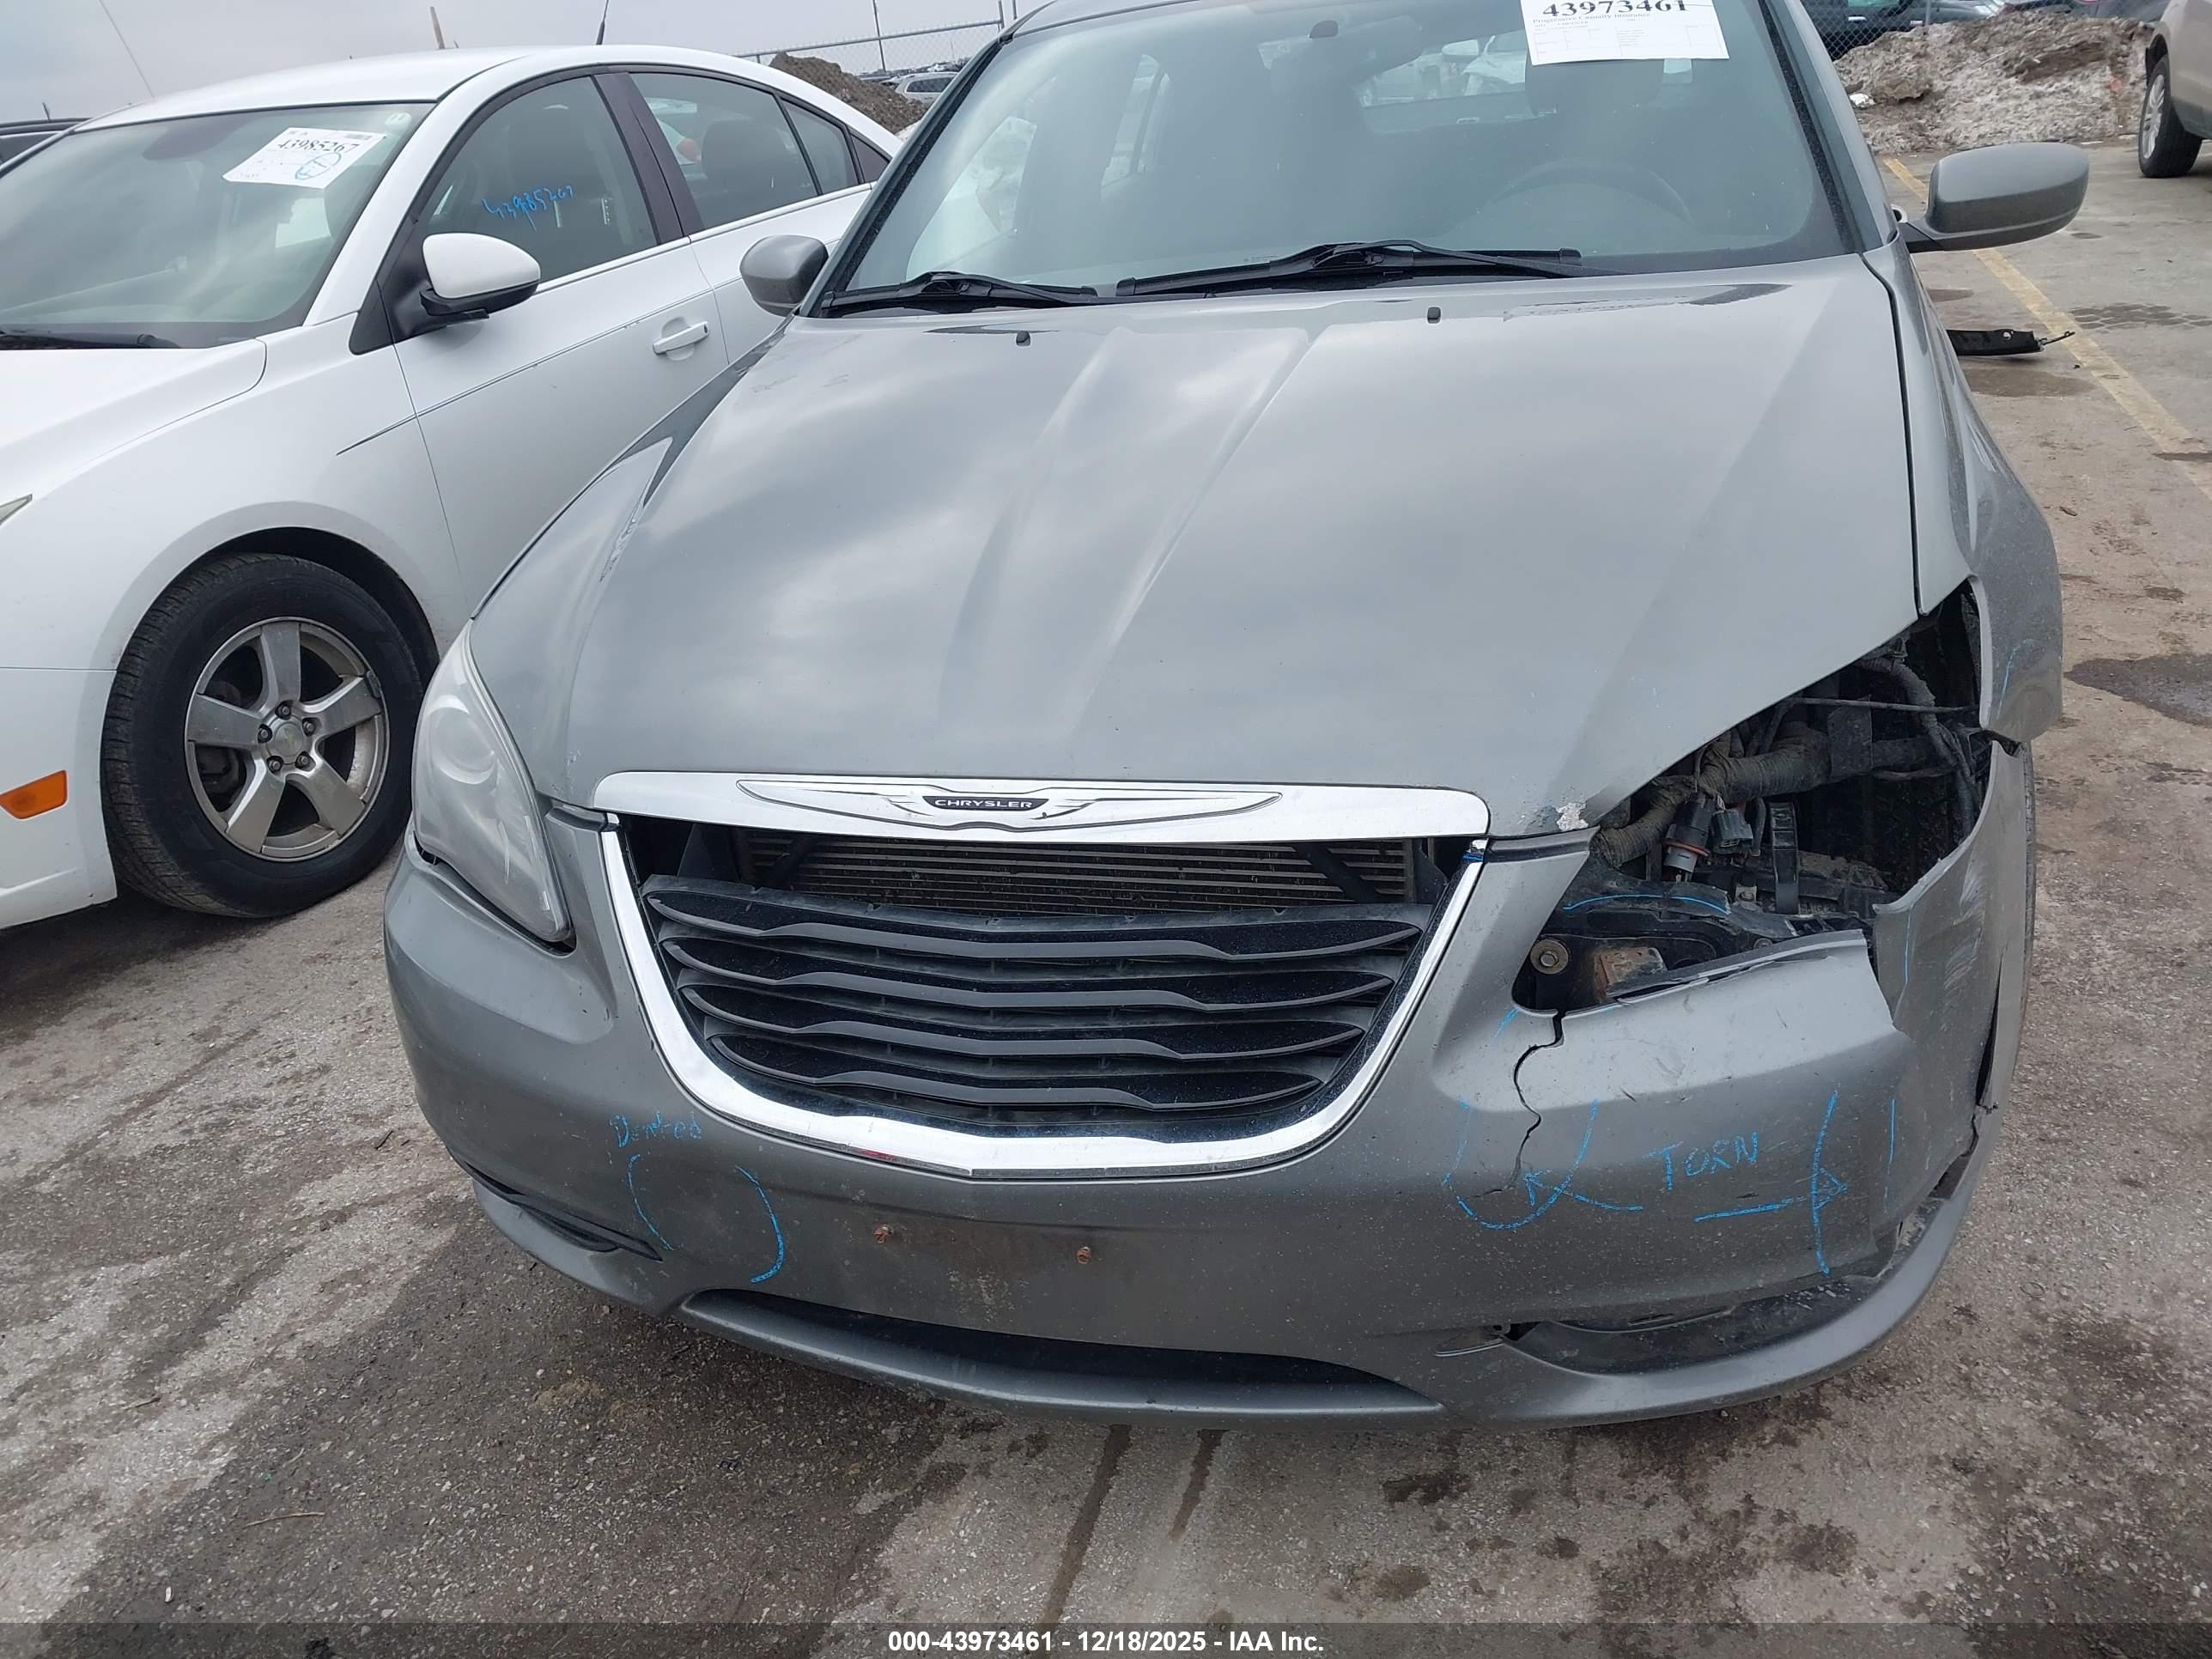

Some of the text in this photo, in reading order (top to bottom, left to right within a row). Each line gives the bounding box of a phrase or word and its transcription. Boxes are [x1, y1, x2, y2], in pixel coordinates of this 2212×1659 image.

[1542, 0, 1692, 17] 43973461
[278, 138, 361, 153] 43985267
[934, 799, 1033, 809] CHRYSLER
[1643, 1131, 1759, 1190] TORN
